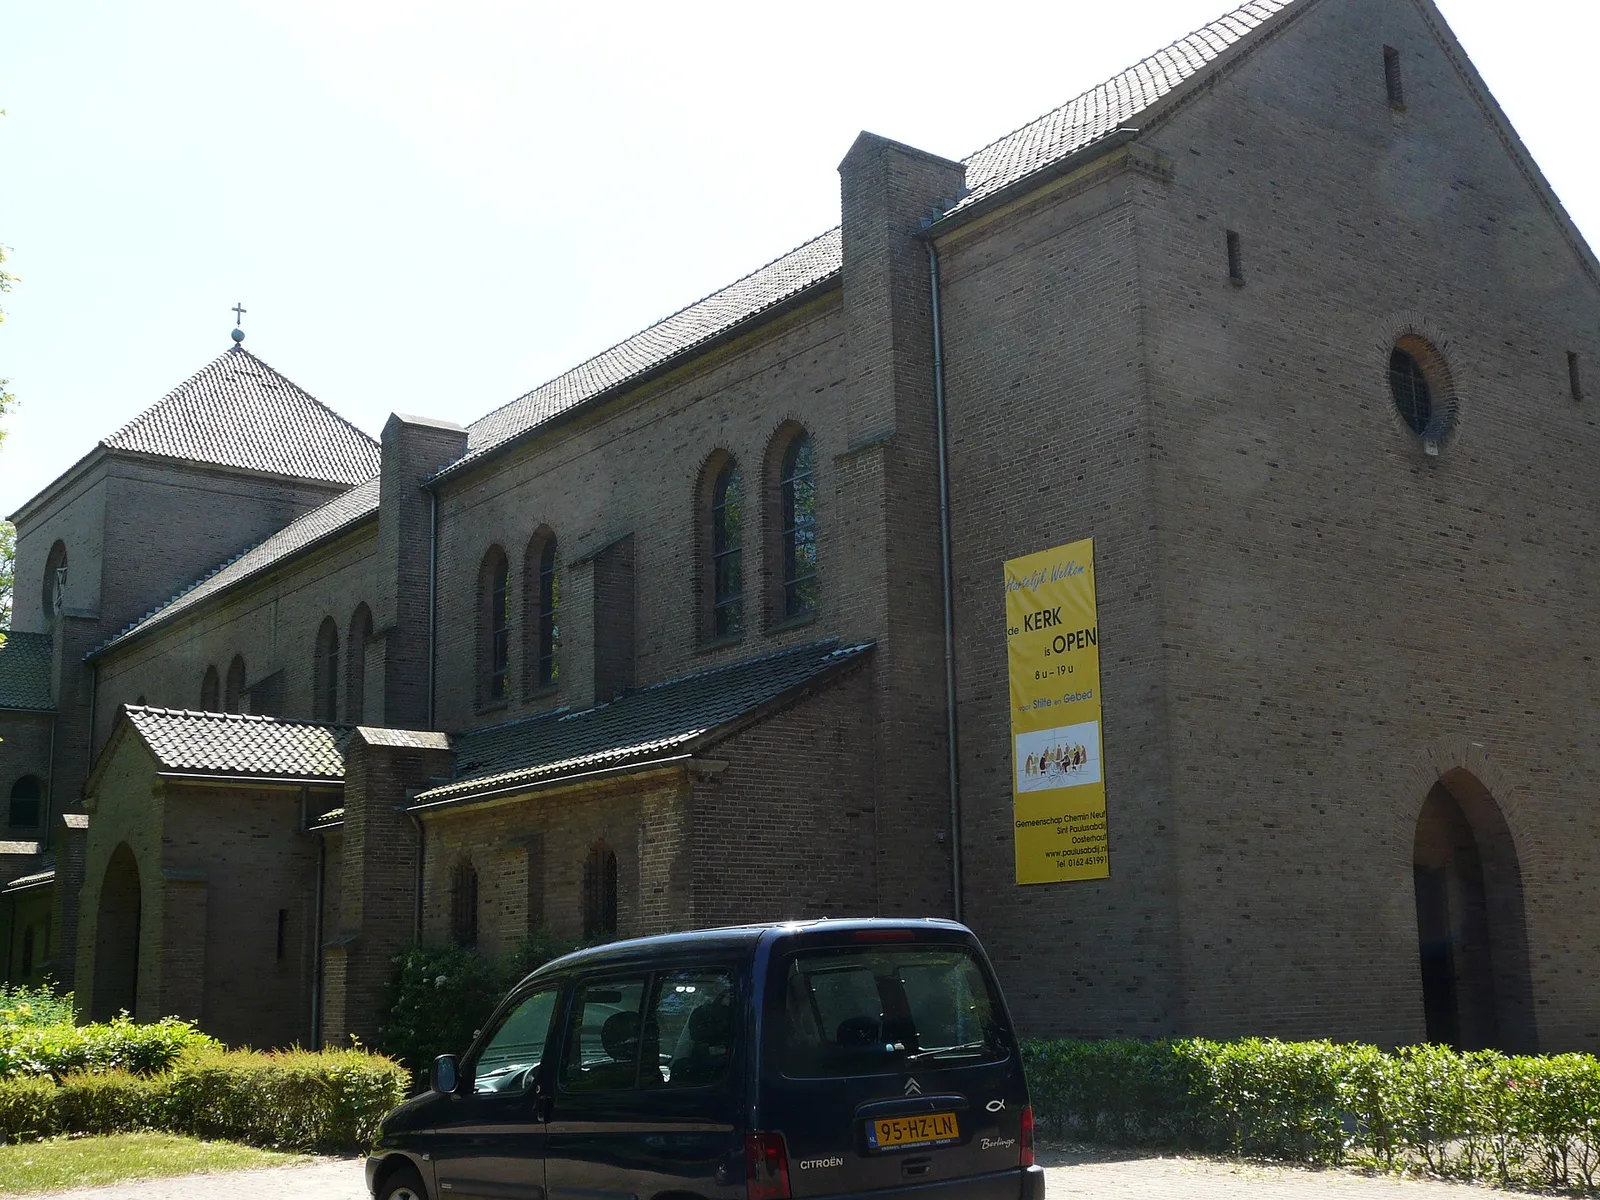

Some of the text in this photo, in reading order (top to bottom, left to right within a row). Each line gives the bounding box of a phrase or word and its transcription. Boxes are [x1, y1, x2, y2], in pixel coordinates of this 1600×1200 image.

[1051, 560, 1085, 583] Welkom
[1008, 606, 1062, 636] de KERK
[1044, 627, 1097, 657] is OPEN
[1063, 689, 1093, 704] Gebed
[1015, 810, 1106, 828] Gemeenschap Chemin Neuf
[1056, 822, 1106, 835] Sint Paulusabdij
[1071, 834, 1107, 845] Oosterhout
[1068, 858, 1084, 867] 0162
[1085, 855, 1108, 866] 451991
[881, 1116, 953, 1141] 95-HZ-LN
[980, 1136, 1016, 1150] Berlingo
[800, 1157, 843, 1170] CITROËN
